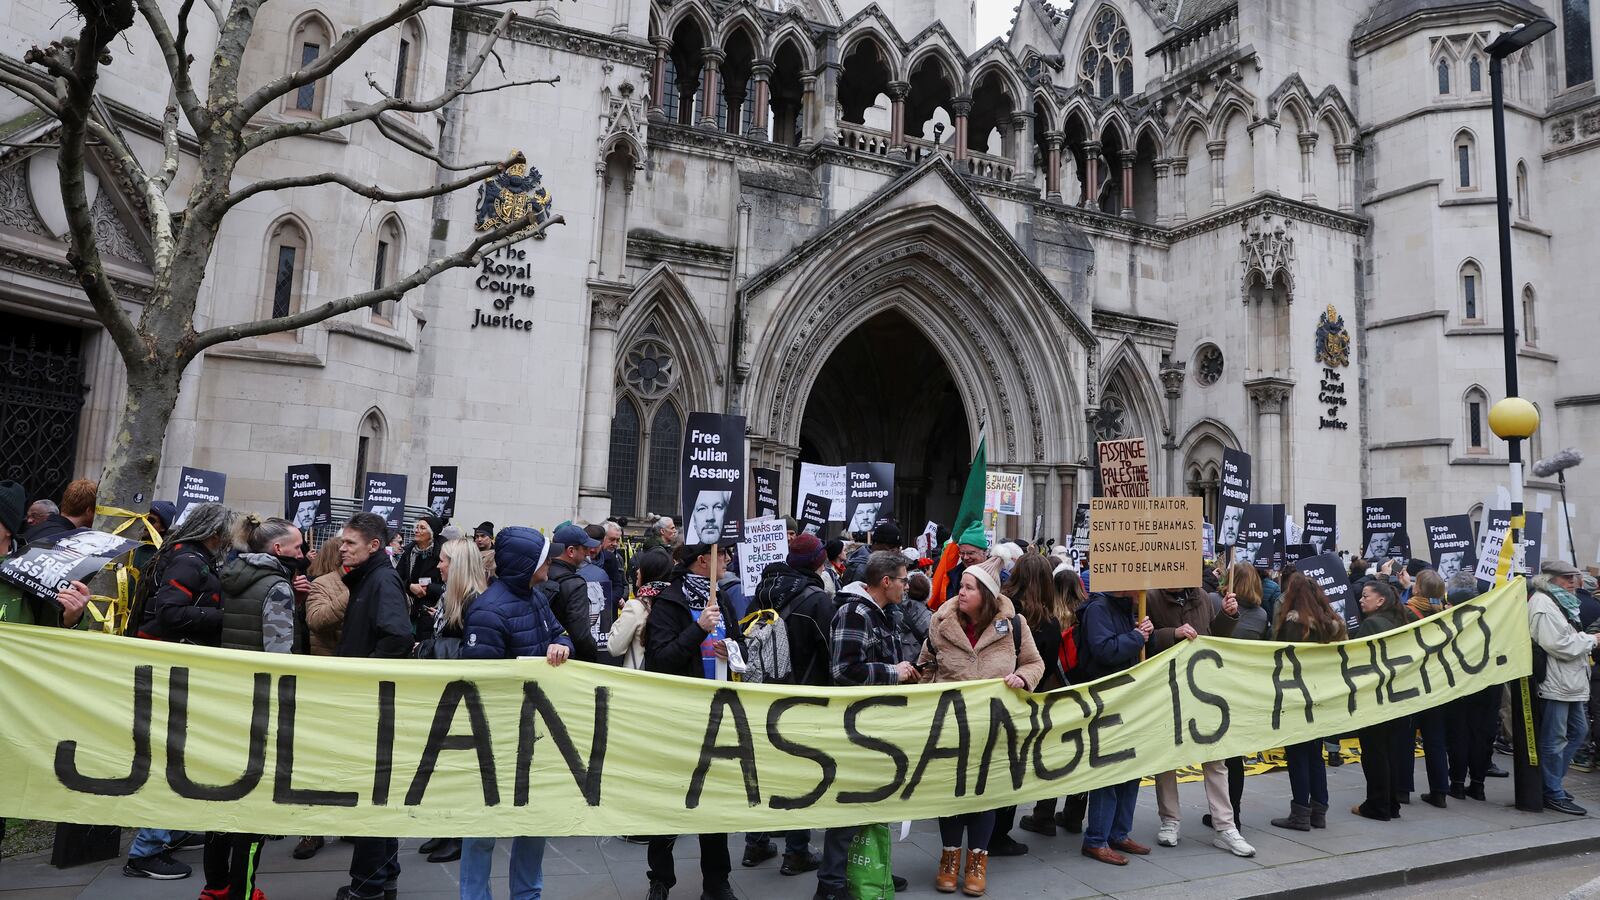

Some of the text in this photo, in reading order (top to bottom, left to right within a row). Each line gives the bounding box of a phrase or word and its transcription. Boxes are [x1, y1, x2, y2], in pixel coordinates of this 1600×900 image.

[495, 243, 527, 260] The
[482, 257, 531, 279] Royal
[476, 275, 535, 297] Courts
[493, 295, 515, 311] of
[471, 308, 533, 331] Justice
[1323, 368, 1341, 381] The
[1320, 380, 1345, 395] Royal
[1318, 392, 1347, 406] Courts
[1327, 406, 1339, 417] of
[1318, 416, 1348, 430] Justice
[691, 429, 720, 444] Free
[689, 447, 728, 462] Julian
[1100, 441, 1146, 463] ASSANGE
[1119, 460, 1132, 469] TO
[1224, 460, 1238, 473] Free
[292, 473, 310, 481] Free
[689, 465, 740, 482] Assange
[851, 472, 871, 480] Free
[1102, 465, 1149, 485] PALESTINE
[184, 475, 204, 484] Free
[369, 479, 386, 487] Free
[757, 476, 769, 485] Free
[992, 475, 1017, 483] JULIAN
[1223, 473, 1243, 487] Julian
[183, 483, 210, 492] Julian
[292, 480, 316, 489] Julian
[851, 480, 877, 489] Julian
[986, 481, 1016, 491] SSANGE
[293, 488, 326, 498] Assange
[431, 486, 454, 494] Assange
[758, 485, 773, 495] Julian
[851, 489, 889, 499] Assange
[1222, 485, 1249, 503] Assange
[183, 490, 220, 502] Assange
[368, 495, 402, 504] Assange
[758, 495, 777, 506] Assange
[806, 499, 818, 508] Free
[1092, 500, 1130, 510] EDWARD
[805, 507, 821, 515] Julian
[1307, 510, 1319, 518] Free
[804, 514, 826, 524] Assange
[1306, 517, 1324, 525] Julian
[751, 524, 771, 533] WARS
[772, 524, 783, 532] can
[929, 525, 937, 533] FR
[1092, 520, 1196, 531] SENT TO THE BAHAMAS.
[1306, 525, 1333, 533] Assange
[1430, 525, 1449, 533] Free
[753, 533, 784, 543] STARTED
[1248, 531, 1269, 539] ange
[1432, 533, 1457, 541] Julian
[1433, 540, 1470, 549] Assange
[1490, 536, 1503, 546] FR
[753, 543, 777, 554] by LIES
[1093, 542, 1139, 552] ASSANGE,
[1139, 541, 1197, 552] JOURNALIST,
[748, 553, 771, 563] PEACE
[34, 554, 74, 577] FREE
[746, 565, 755, 573] be
[1093, 563, 1118, 573] SENT
[1122, 563, 1134, 572] TO
[9, 557, 77, 592] ASSANGE
[1303, 567, 1325, 577] Free
[2, 567, 14, 577] NO
[13, 572, 25, 583] U.S.
[25, 579, 60, 600] EXTRADIT
[751, 574, 758, 583] by
[1317, 576, 1335, 586] lian
[1323, 584, 1348, 596] sange
[54, 665, 610, 807] JULIAN
[685, 673, 1136, 810] ASSANGE
[1168, 648, 1230, 746] IS
[1272, 645, 1314, 730] A
[1337, 604, 1508, 716] HERO.
